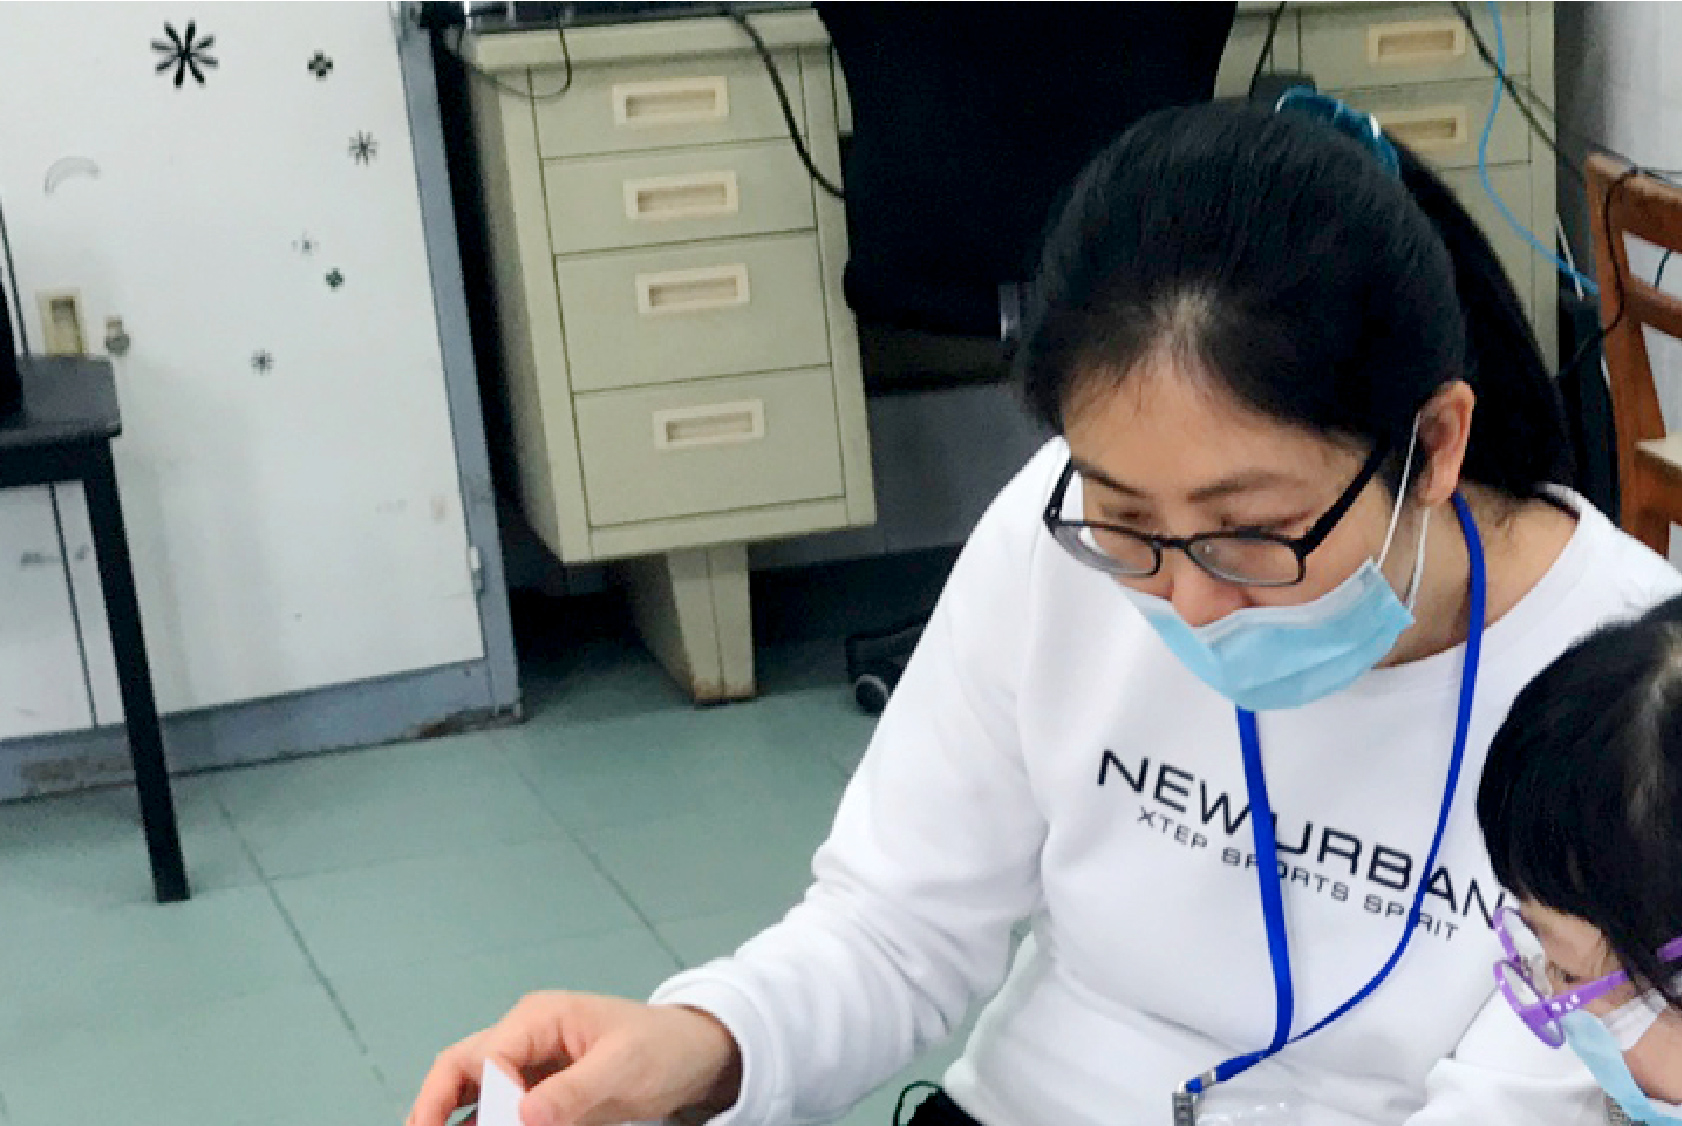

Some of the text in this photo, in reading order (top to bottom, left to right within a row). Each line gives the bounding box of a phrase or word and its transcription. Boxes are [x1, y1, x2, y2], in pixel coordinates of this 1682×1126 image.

[1096, 748, 1506, 930] NEW URBAN
[1137, 806, 1208, 850] XTEP
